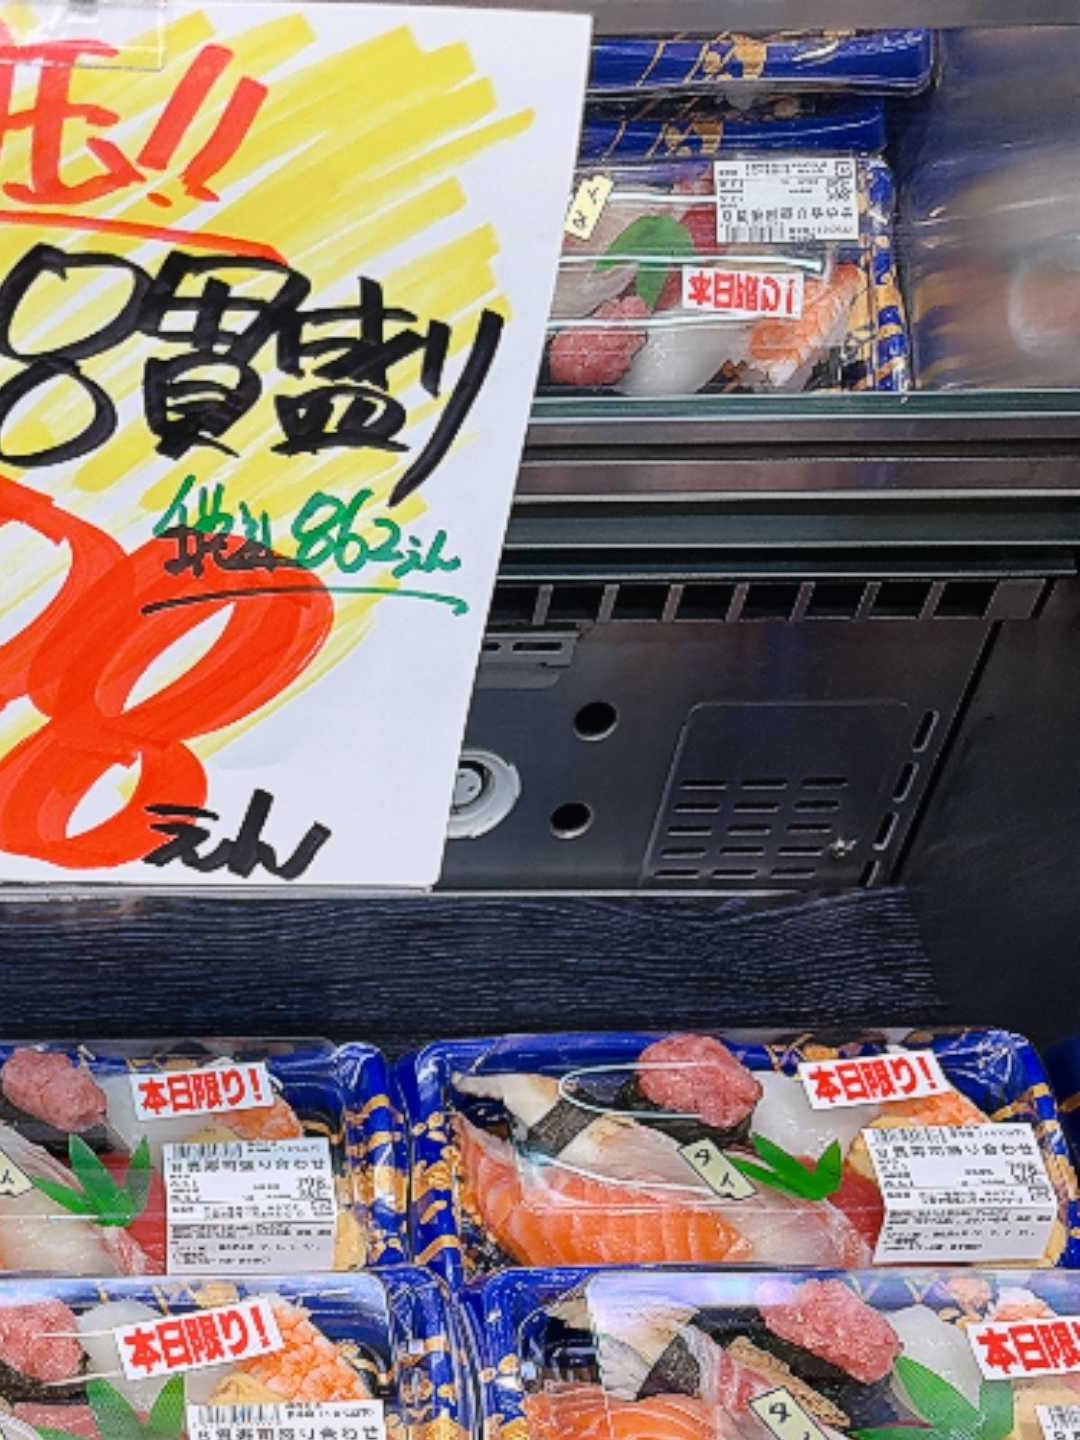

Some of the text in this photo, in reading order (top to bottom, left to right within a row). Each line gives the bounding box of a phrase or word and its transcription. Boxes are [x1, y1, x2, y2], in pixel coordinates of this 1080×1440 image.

[137, 1068, 263, 1114] 本日限り!
[808, 1055, 940, 1103] 本日限り!
[123, 1304, 271, 1376] 本日限り!
[976, 1320, 1080, 1375] 本日限
